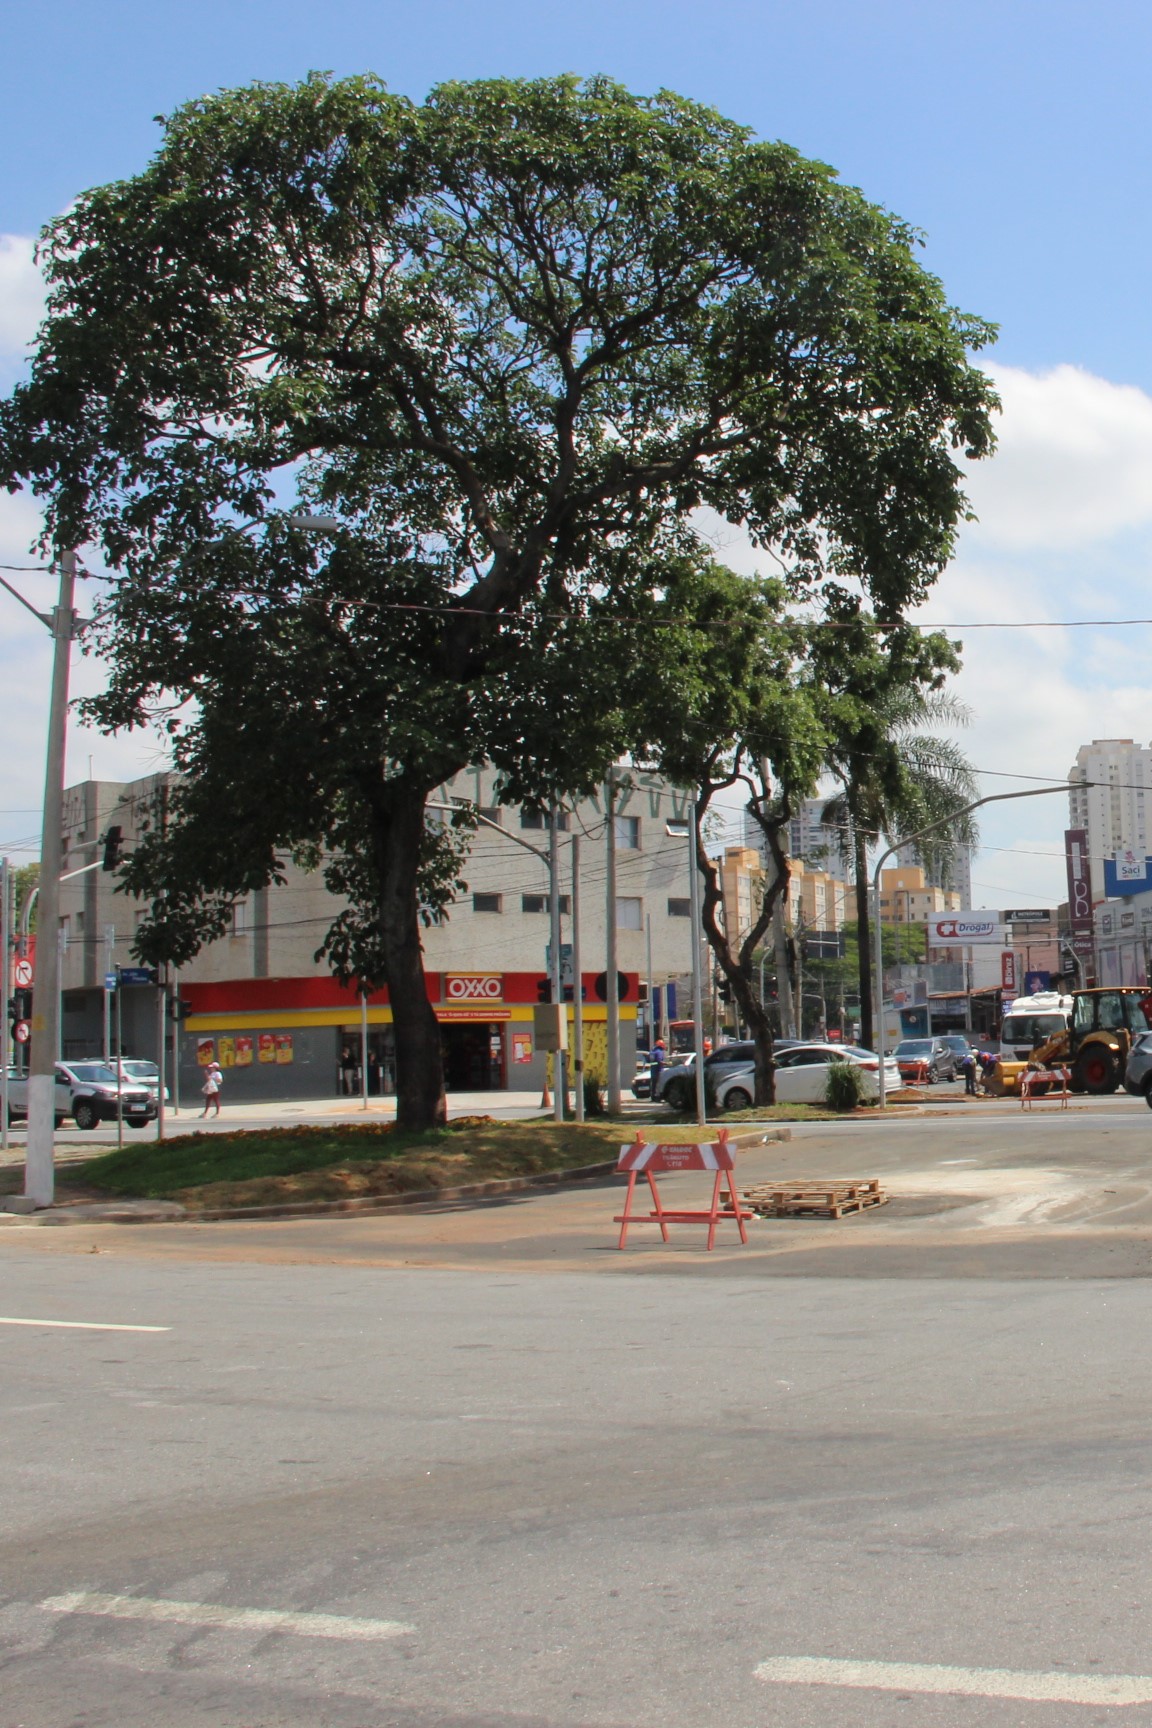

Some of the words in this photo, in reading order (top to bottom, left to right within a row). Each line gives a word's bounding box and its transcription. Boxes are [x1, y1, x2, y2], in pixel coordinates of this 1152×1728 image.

[1122, 866, 1140, 874] Saci
[959, 922, 990, 932] Drogal
[449, 977, 501, 998] OXXO
